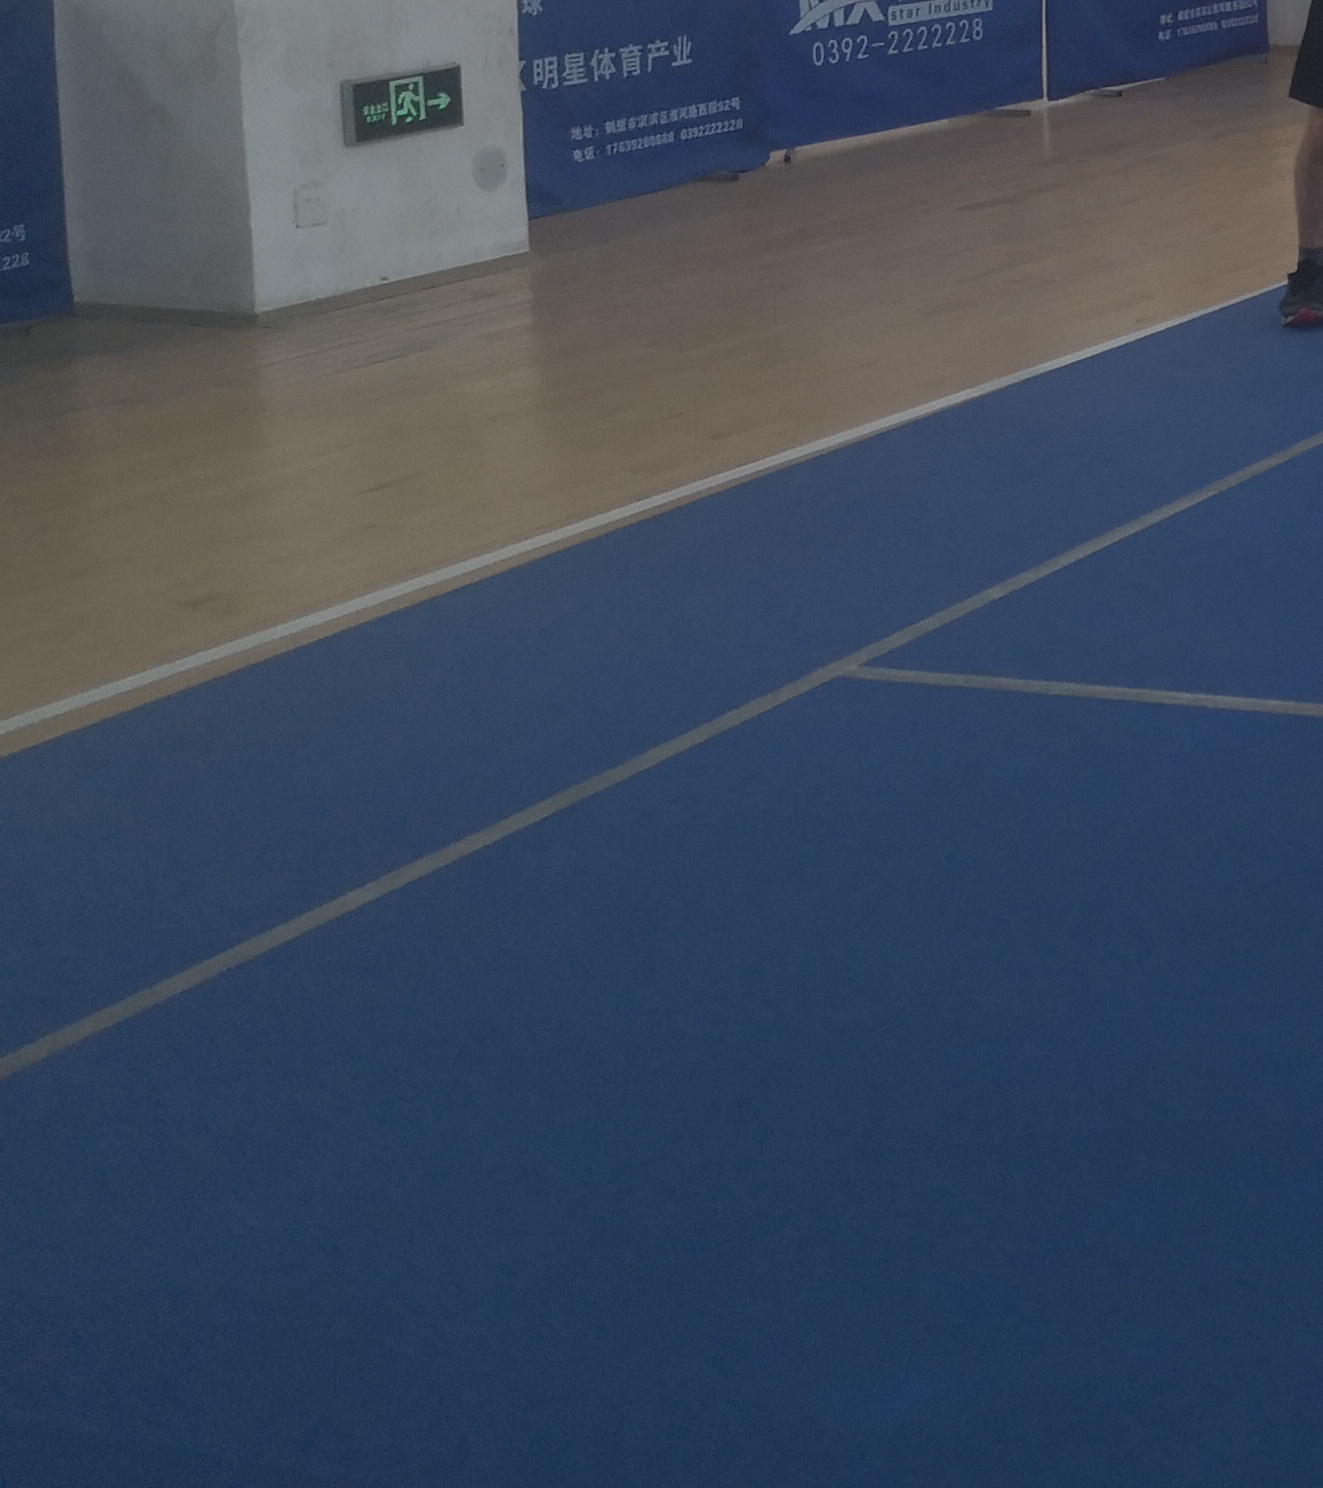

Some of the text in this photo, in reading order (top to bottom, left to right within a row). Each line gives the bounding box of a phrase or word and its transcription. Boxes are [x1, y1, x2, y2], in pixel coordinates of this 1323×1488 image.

[532, 34, 693, 90] 明星体育产业
[812, 17, 984, 67] 0392-2222228
